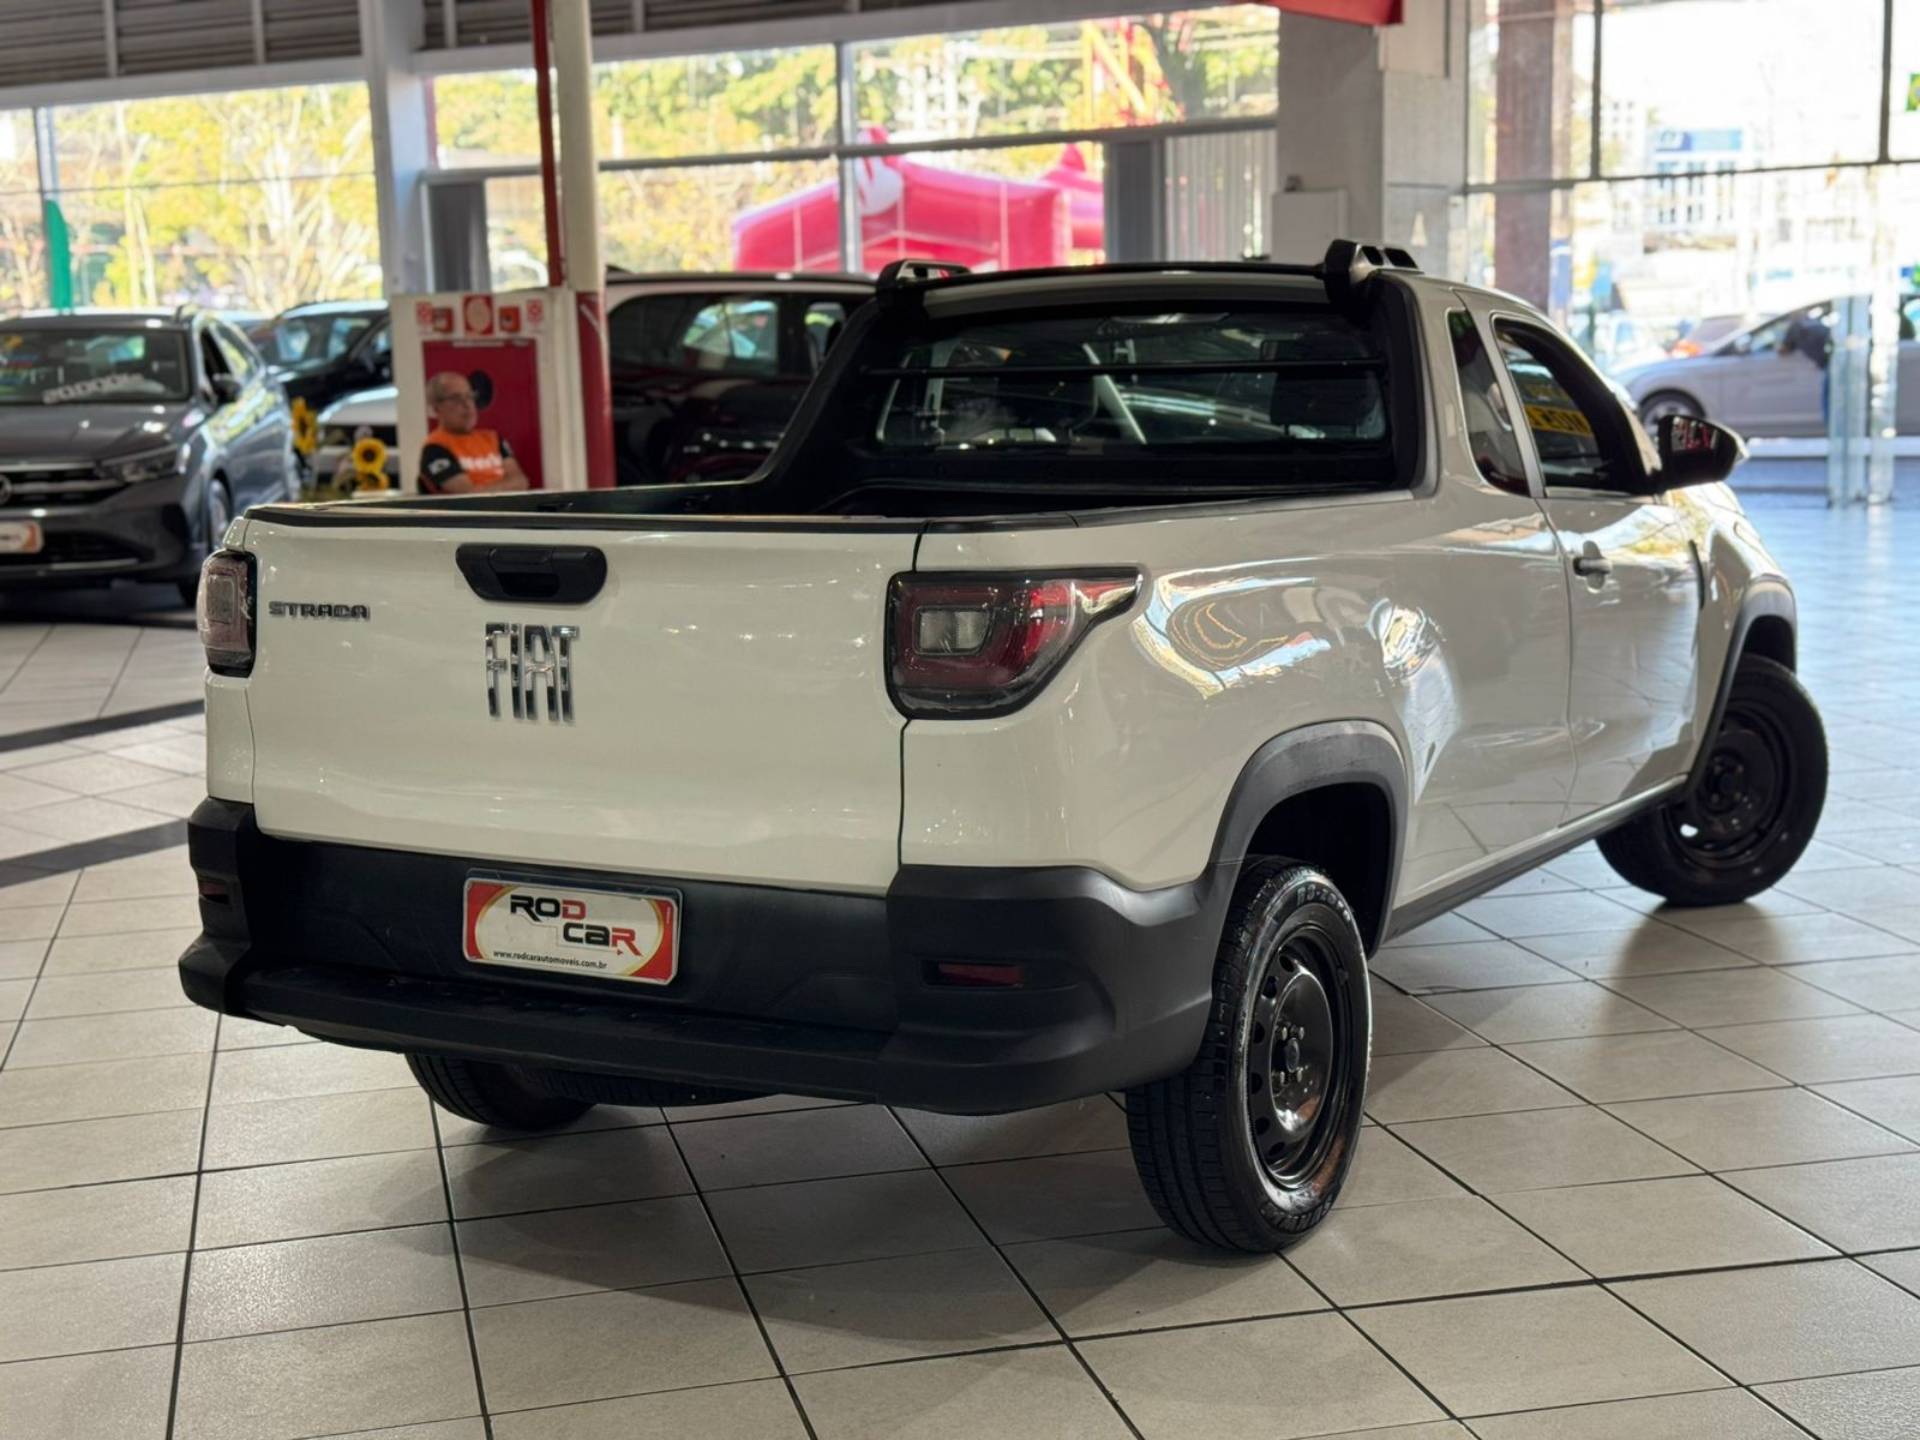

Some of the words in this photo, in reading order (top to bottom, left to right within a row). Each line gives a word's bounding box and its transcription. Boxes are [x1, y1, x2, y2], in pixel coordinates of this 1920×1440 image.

[269, 601, 368, 619] STRADA
[485, 622, 579, 722] FIAT
[493, 950, 608, 970] www.rodcarautomoveis.com.br
